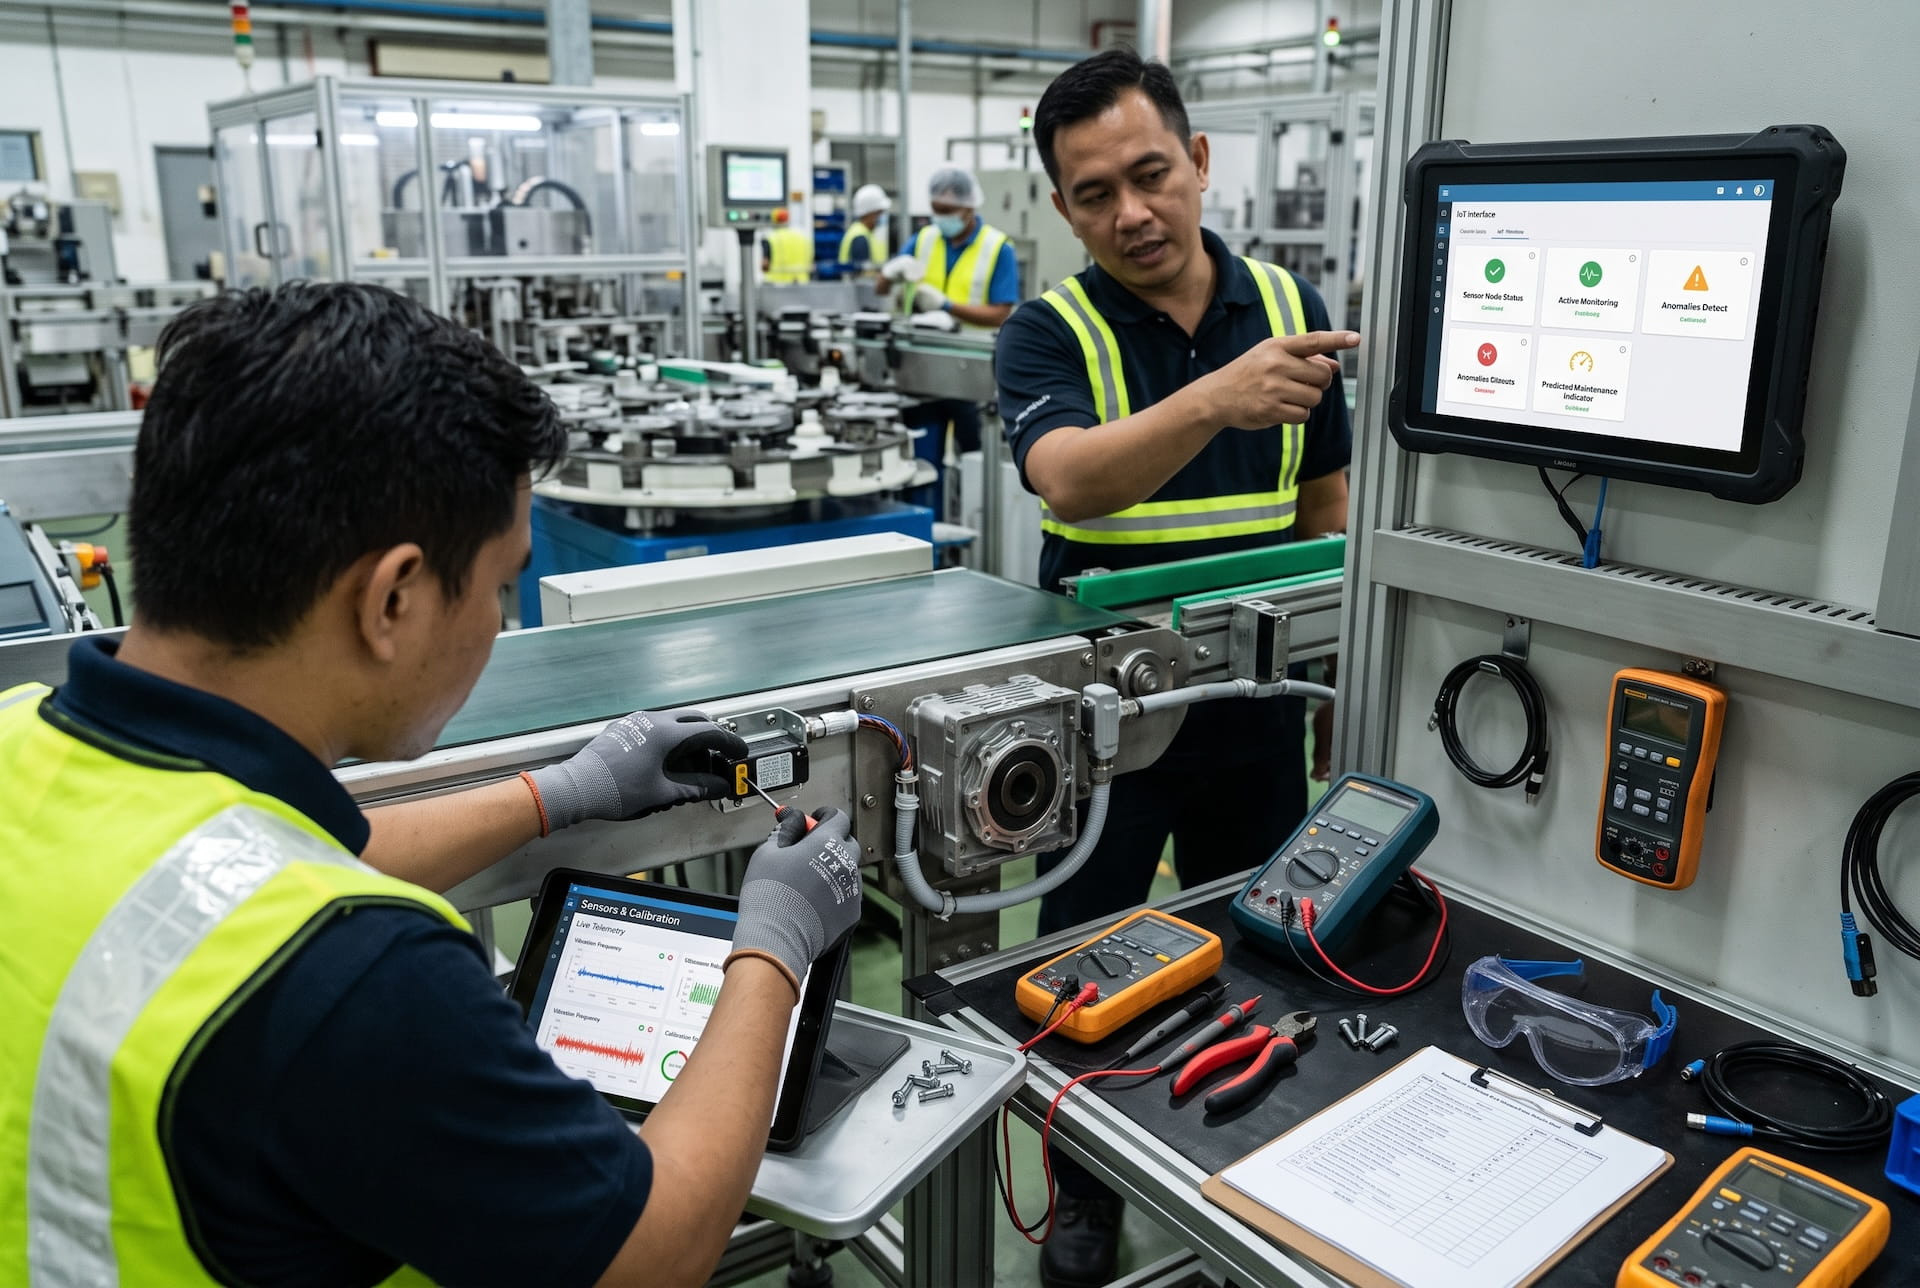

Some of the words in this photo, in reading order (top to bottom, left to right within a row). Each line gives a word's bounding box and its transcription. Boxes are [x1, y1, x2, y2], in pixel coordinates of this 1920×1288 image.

[1456, 210, 1467, 219] IoT
[1463, 291, 1484, 300] Sensor
[1485, 292, 1502, 301] Node
[1503, 293, 1524, 302] Status
[1558, 296, 1580, 304] Active
[1580, 297, 1619, 309] Monitoring
[1661, 301, 1701, 311] Anomalies
[1702, 303, 1728, 312] Detect
[1457, 373, 1489, 383] Anomalies
[1541, 380, 1574, 391] Predicted
[1574, 384, 1618, 395] Maintenance
[1563, 392, 1594, 402] Indicator
[581, 899, 619, 915] Sensors
[619, 906, 627, 916] &
[629, 908, 681, 925] Calibration
[576, 920, 591, 929] Live
[592, 923, 626, 936] Telemetry
[597, 941, 622, 952] Frequency
[664, 1030, 692, 1041] Calibration
